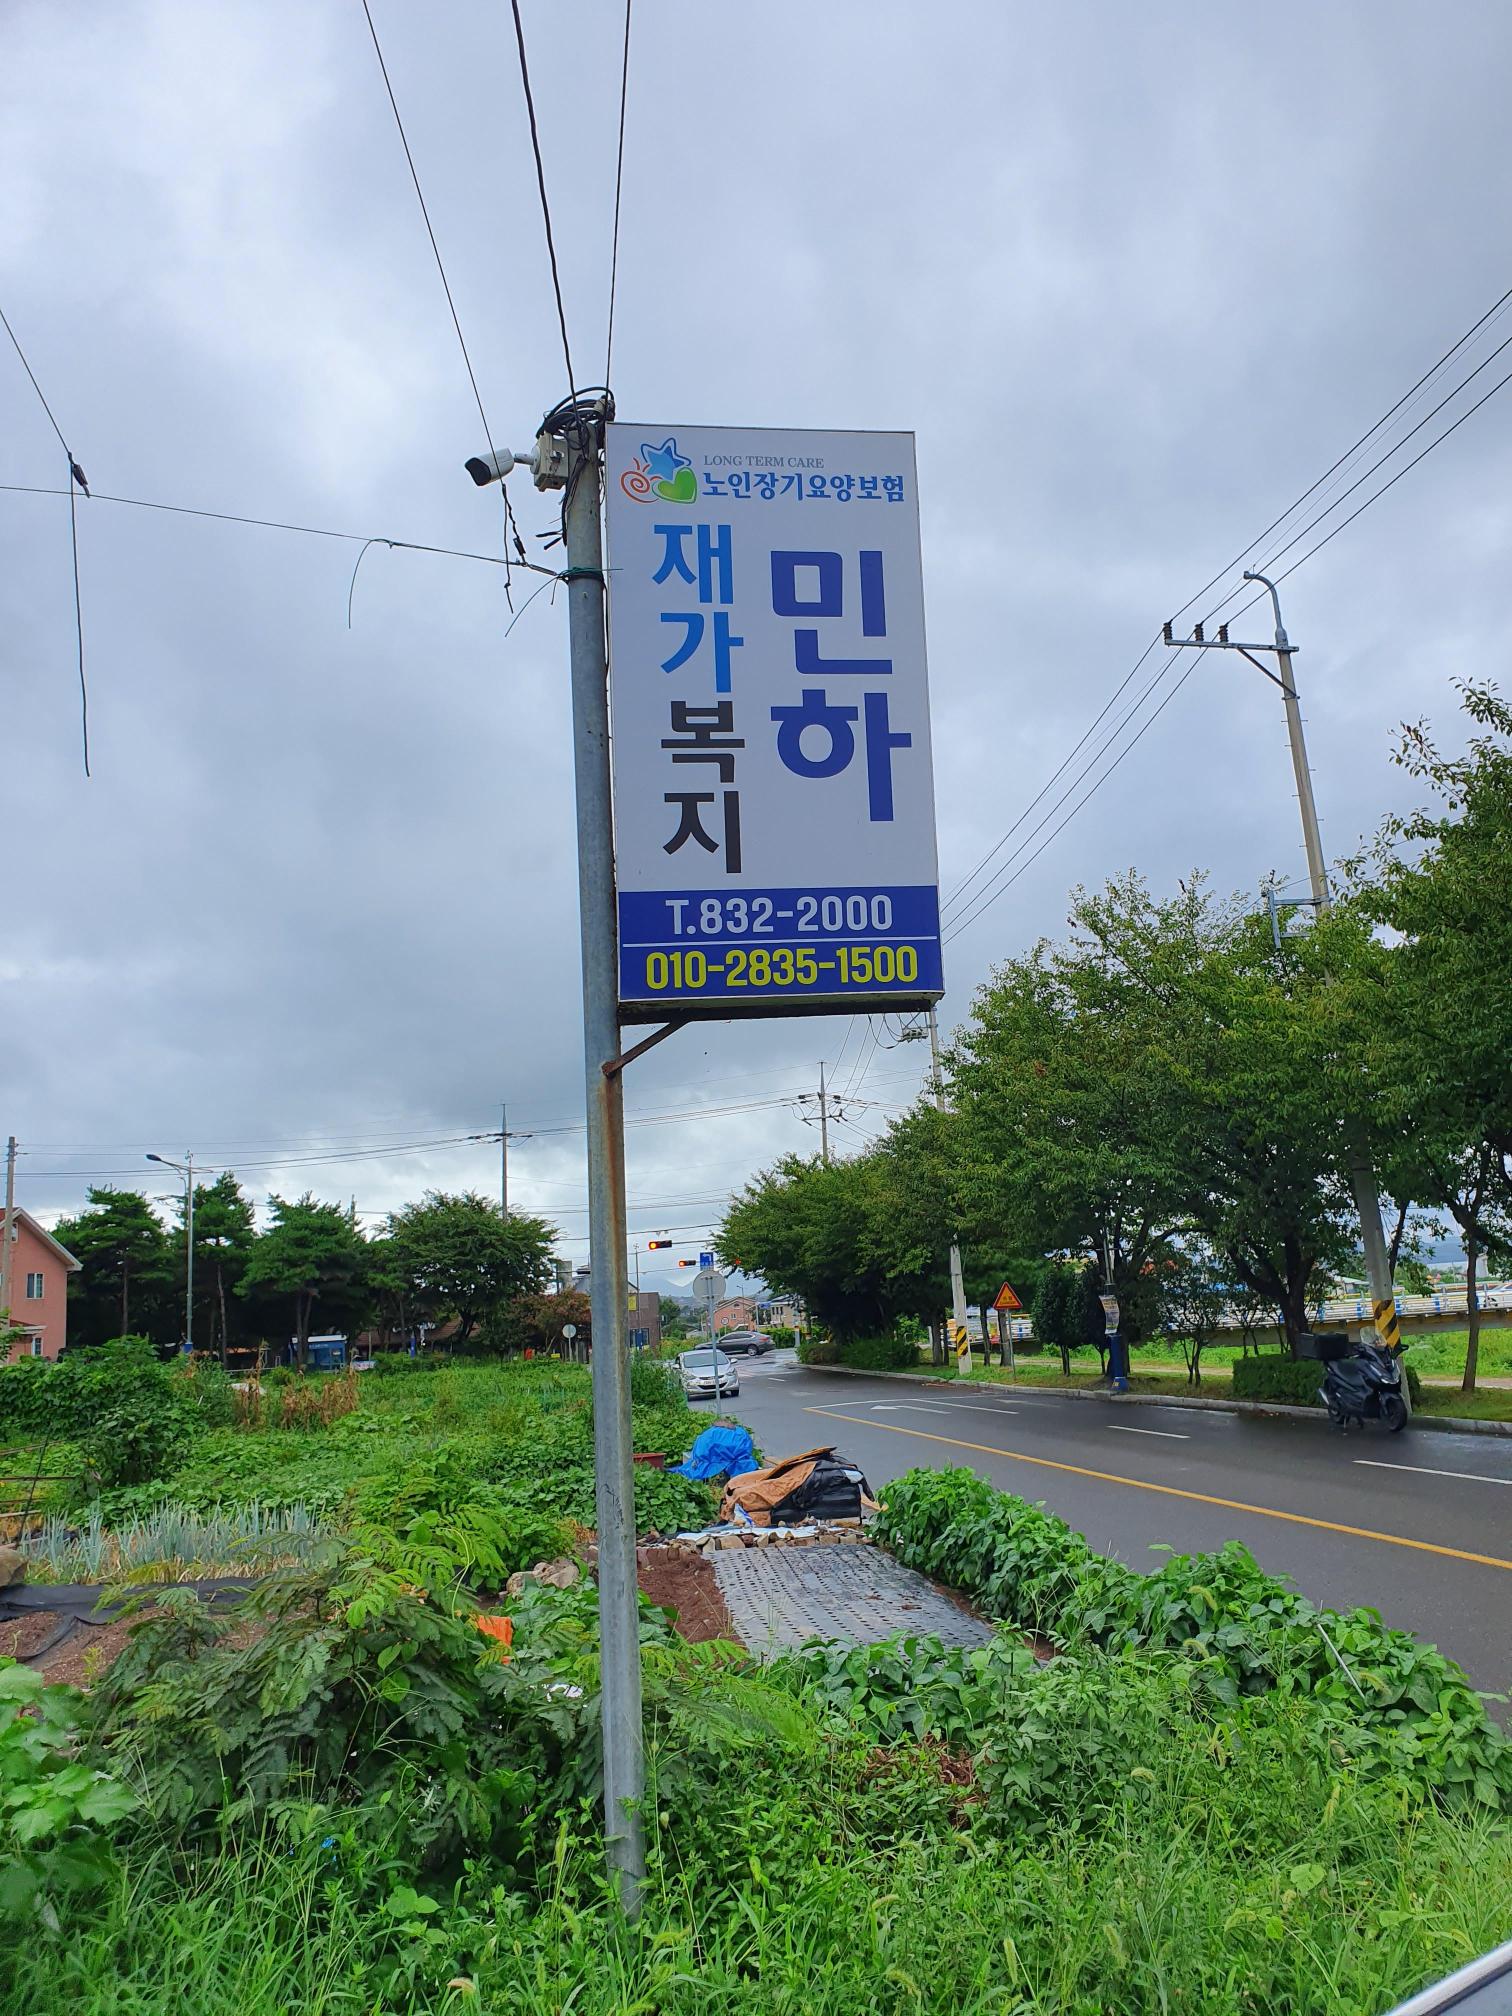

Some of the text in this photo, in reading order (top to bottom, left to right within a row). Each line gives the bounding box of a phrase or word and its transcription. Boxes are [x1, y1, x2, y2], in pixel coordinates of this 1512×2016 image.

[703, 455, 825, 469] LONG TERM CARE
[702, 471, 905, 503] 노인장기요양보험
[770, 550, 912, 822] 민하
[665, 895, 893, 935] T.832-2000
[645, 945, 918, 990] 010-2835-1500
